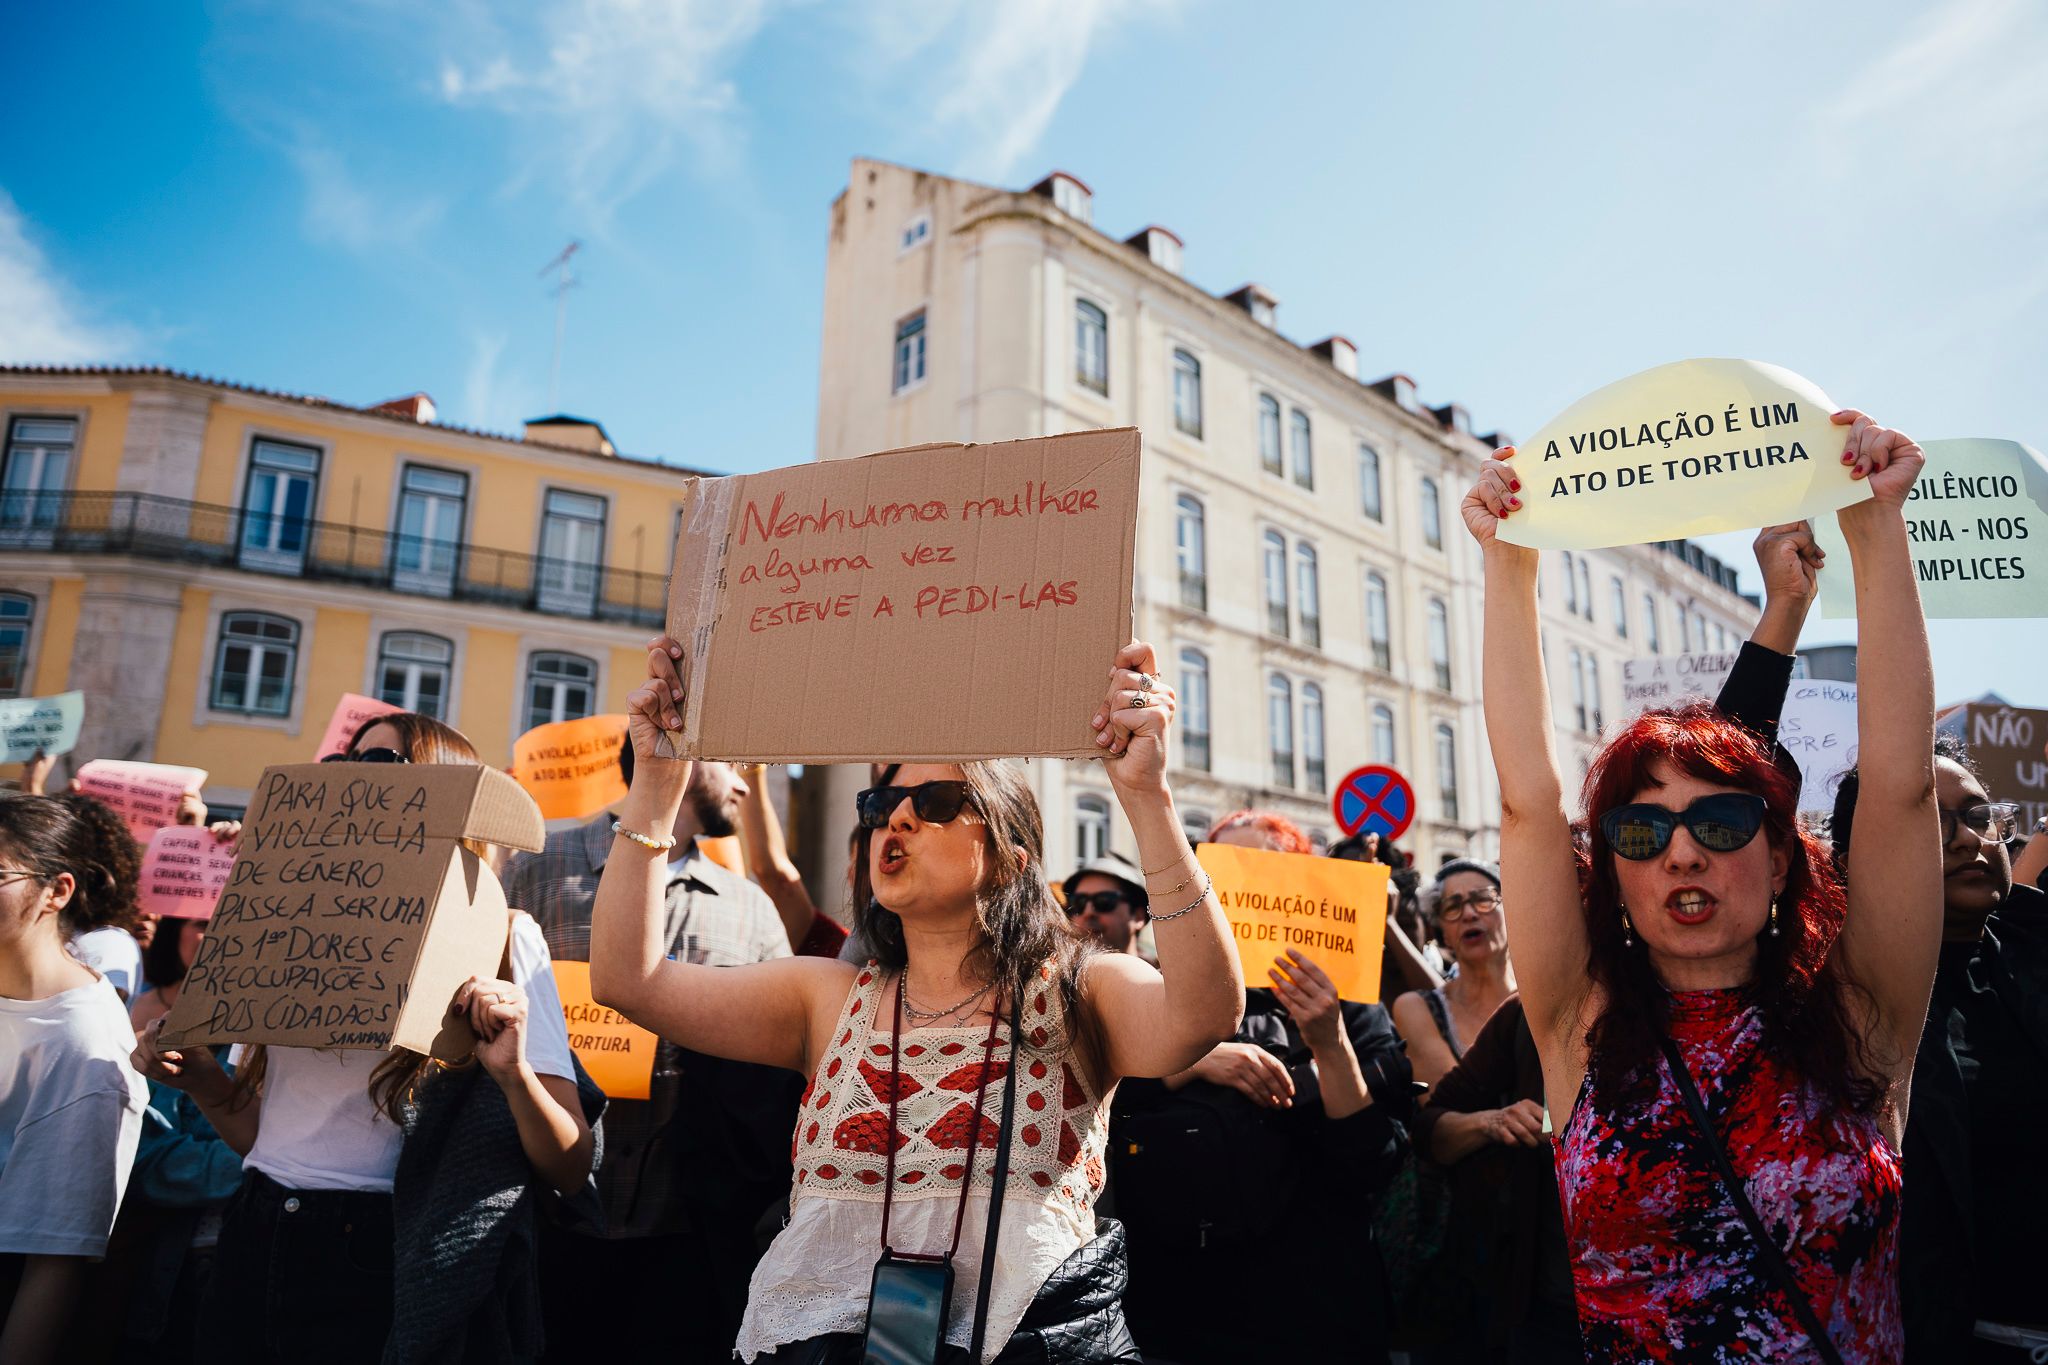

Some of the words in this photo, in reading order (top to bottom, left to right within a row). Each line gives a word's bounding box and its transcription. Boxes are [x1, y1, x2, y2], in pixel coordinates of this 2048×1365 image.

[1543, 439, 1561, 462] A
[1569, 411, 1714, 449] VIOLAÇÃO
[1724, 404, 1742, 433] É
[1750, 402, 1799, 429] UM
[1550, 471, 1607, 498] ATO
[1617, 464, 1654, 488] DE
[1662, 441, 1810, 481] TORTURA
[739, 490, 949, 545] Nenhuma
[1906, 519, 1955, 542] RNA
[1977, 516, 2029, 541] NOS
[739, 548, 874, 593] alguma
[901, 543, 956, 567] vez
[1914, 556, 2025, 582] MPLICES
[749, 594, 859, 632] ESTEVE
[873, 596, 894, 618] A
[913, 580, 1079, 618] PEDI-LAS
[1973, 706, 2034, 750] NÃO
[340, 778, 395, 816] QUE
[402, 786, 427, 815] A
[232, 860, 269, 886] DE
[212, 893, 289, 932] PASSE
[321, 895, 374, 919] SER
[379, 896, 426, 925] UMA
[1234, 890, 1315, 919] VIOLAÇÃO
[1320, 898, 1329, 919] É
[1333, 905, 1356, 924] UM
[193, 934, 245, 969] DAS
[381, 938, 404, 963] E
[1232, 922, 1251, 939] TO
[1257, 924, 1278, 942] DE
[1283, 926, 1355, 955] TORTURA
[208, 998, 258, 1036] DOS
[563, 1003, 600, 1025] AÇÃO
